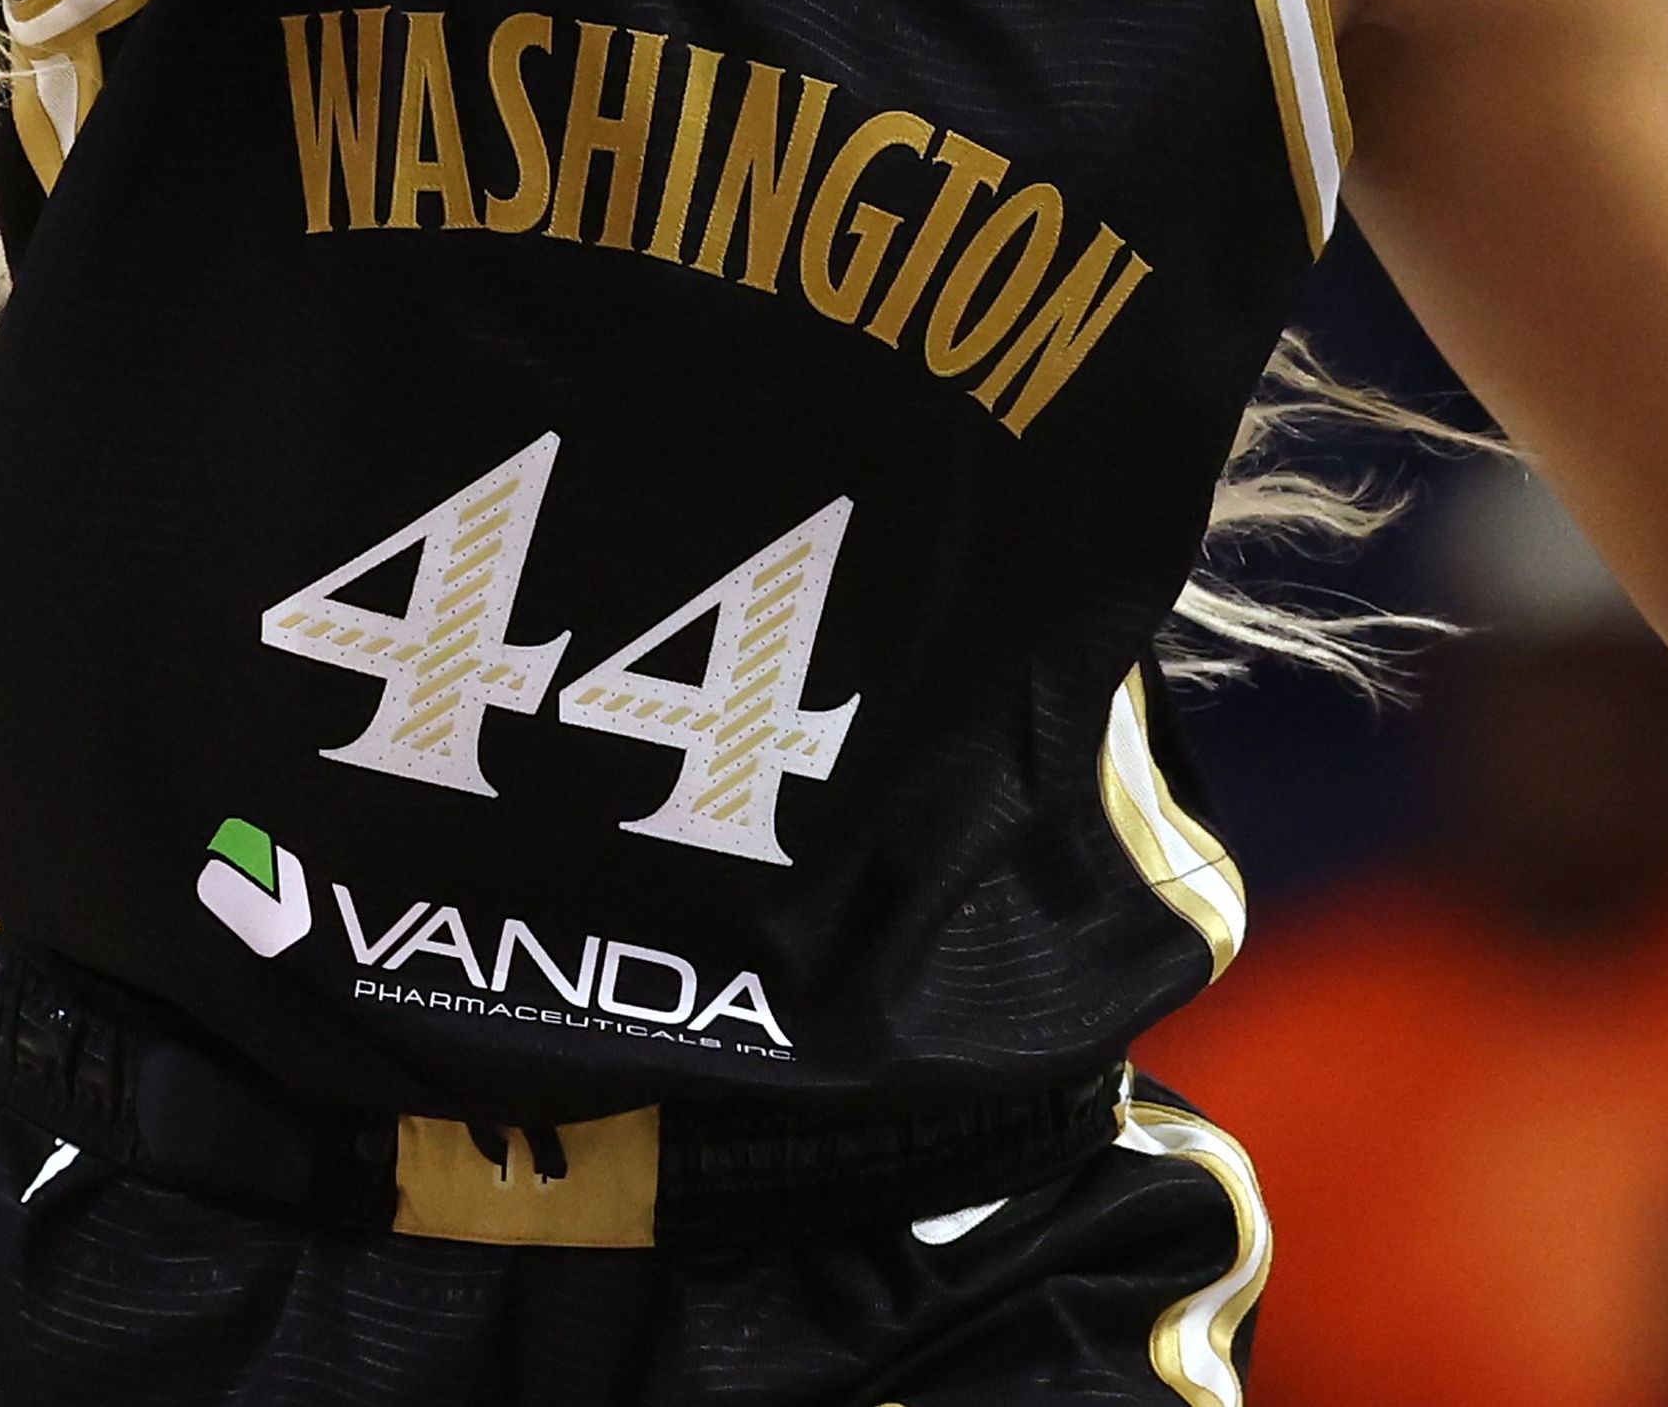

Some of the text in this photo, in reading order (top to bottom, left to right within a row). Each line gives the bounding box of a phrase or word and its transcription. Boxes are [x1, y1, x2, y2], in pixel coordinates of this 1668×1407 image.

[280, 3, 1155, 441] WASHINGTON
[260, 430, 862, 867] 44
[331, 881, 795, 1049] VANDA
[353, 978, 723, 1050] PHARMACEUTICALS
